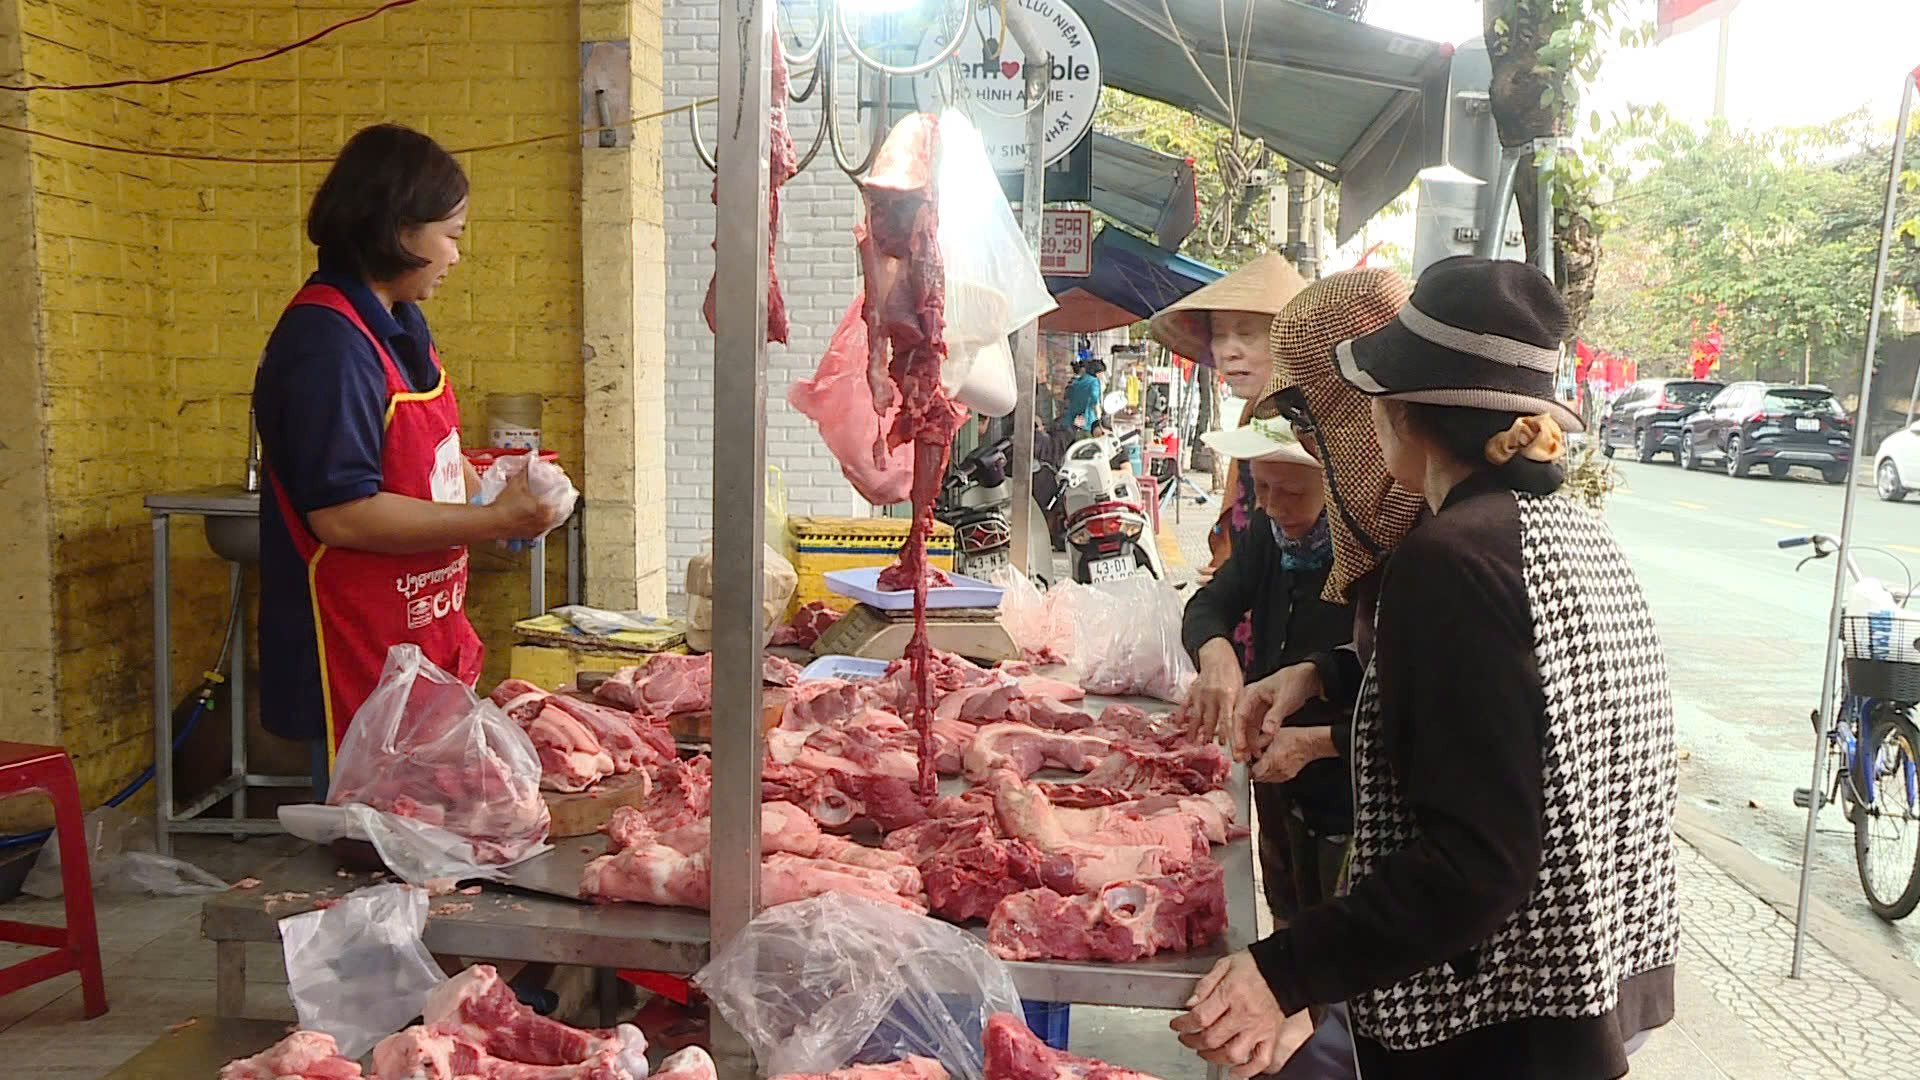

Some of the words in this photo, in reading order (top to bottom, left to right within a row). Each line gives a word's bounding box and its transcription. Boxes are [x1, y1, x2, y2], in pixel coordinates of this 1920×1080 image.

[1052, 13, 1081, 48] NIỆM
[976, 86, 1012, 101] HÌNH
[1001, 143, 1027, 159] SIN
[1055, 218, 1082, 236] SPA
